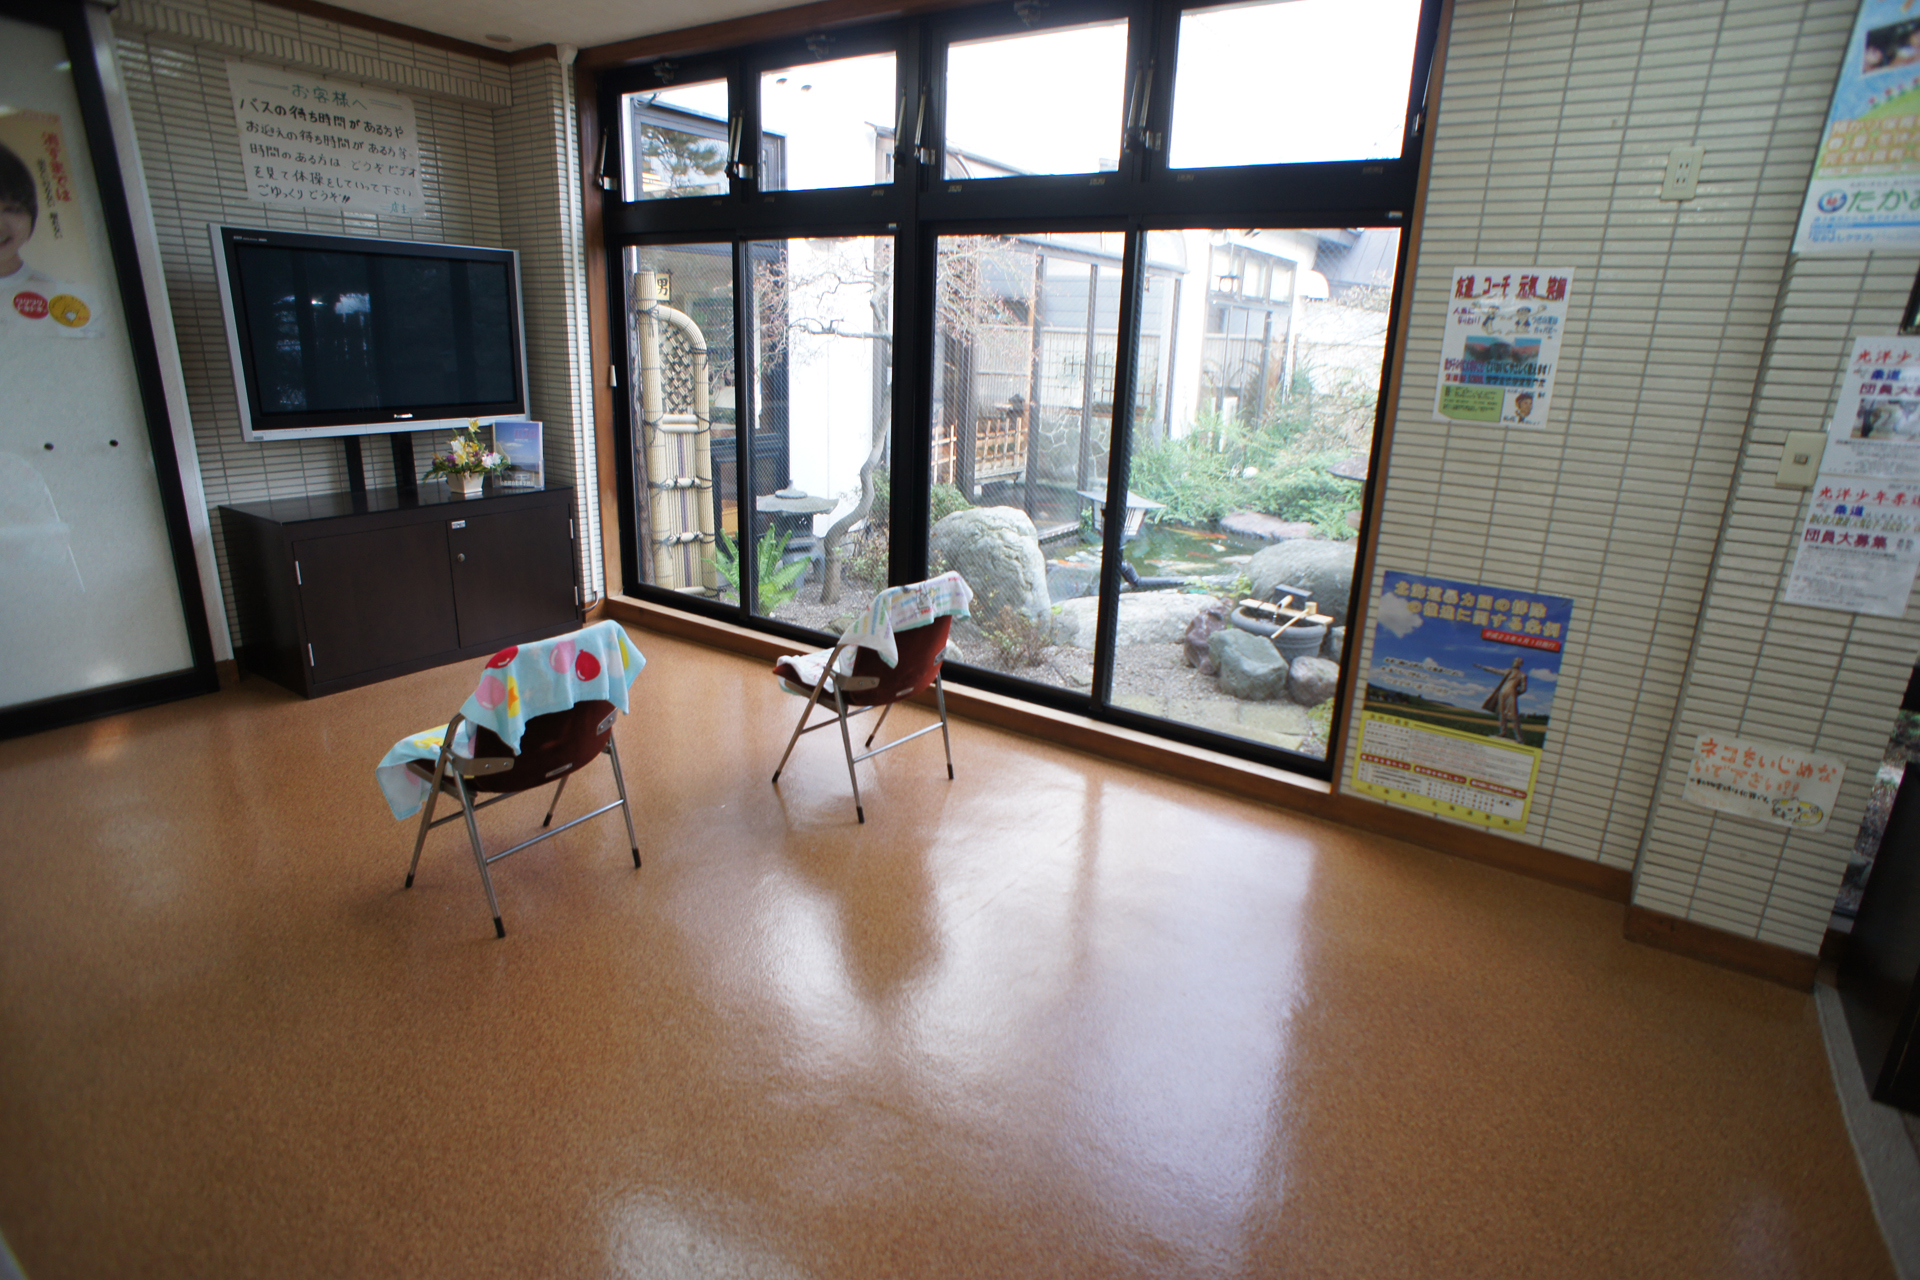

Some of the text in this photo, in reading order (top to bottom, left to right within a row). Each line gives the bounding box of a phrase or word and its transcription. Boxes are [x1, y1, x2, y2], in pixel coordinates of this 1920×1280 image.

[292, 84, 368, 111] お客様へ
[657, 278, 668, 296] 男
[1482, 275, 1511, 299] コーチ
[1856, 350, 1920, 366] 光洋少
[1804, 527, 1889, 551] 団員大募集
[1701, 737, 1837, 784] ネコをいじめな
